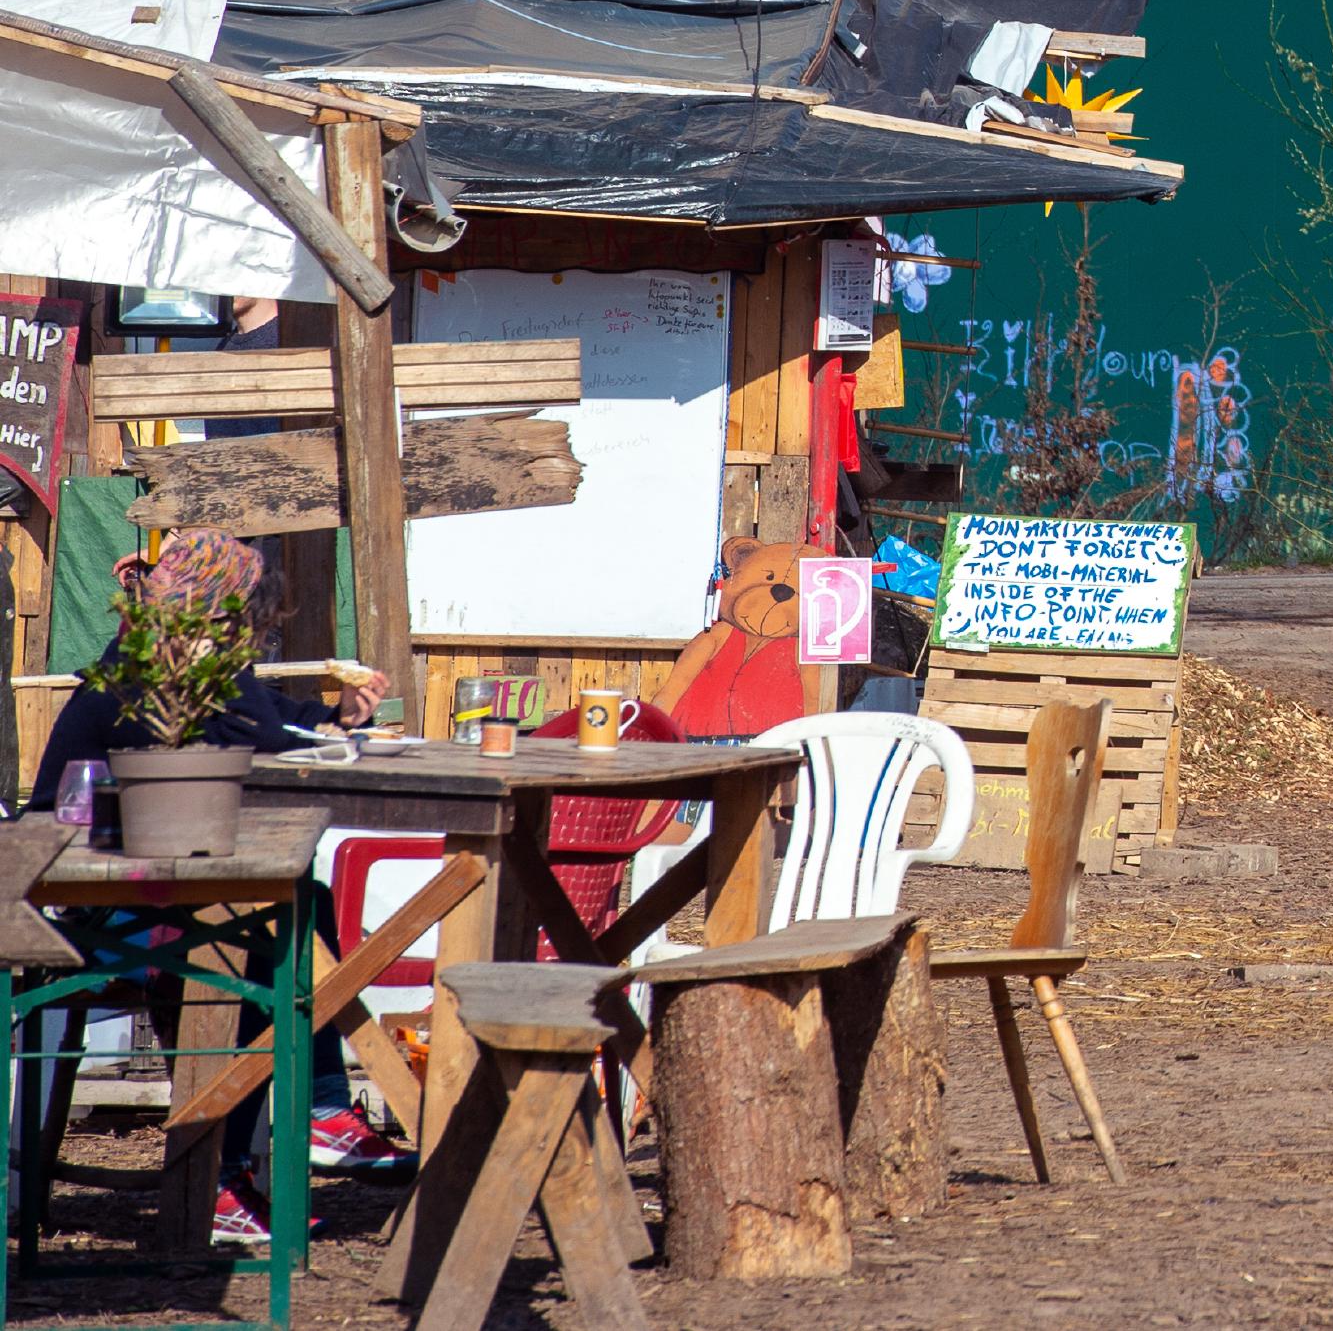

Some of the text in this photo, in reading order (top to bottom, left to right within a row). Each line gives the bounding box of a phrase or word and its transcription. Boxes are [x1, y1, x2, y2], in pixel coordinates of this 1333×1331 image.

[964, 516, 1019, 539] MOIN
[973, 540, 1155, 559] DONT FORGET
[964, 562, 1009, 577] THE
[965, 583, 1123, 603] INSIDE OF THE
[1115, 608, 1168, 624] WHEN
[986, 623, 1021, 639] YOU
[1025, 626, 1062, 641] ARE
